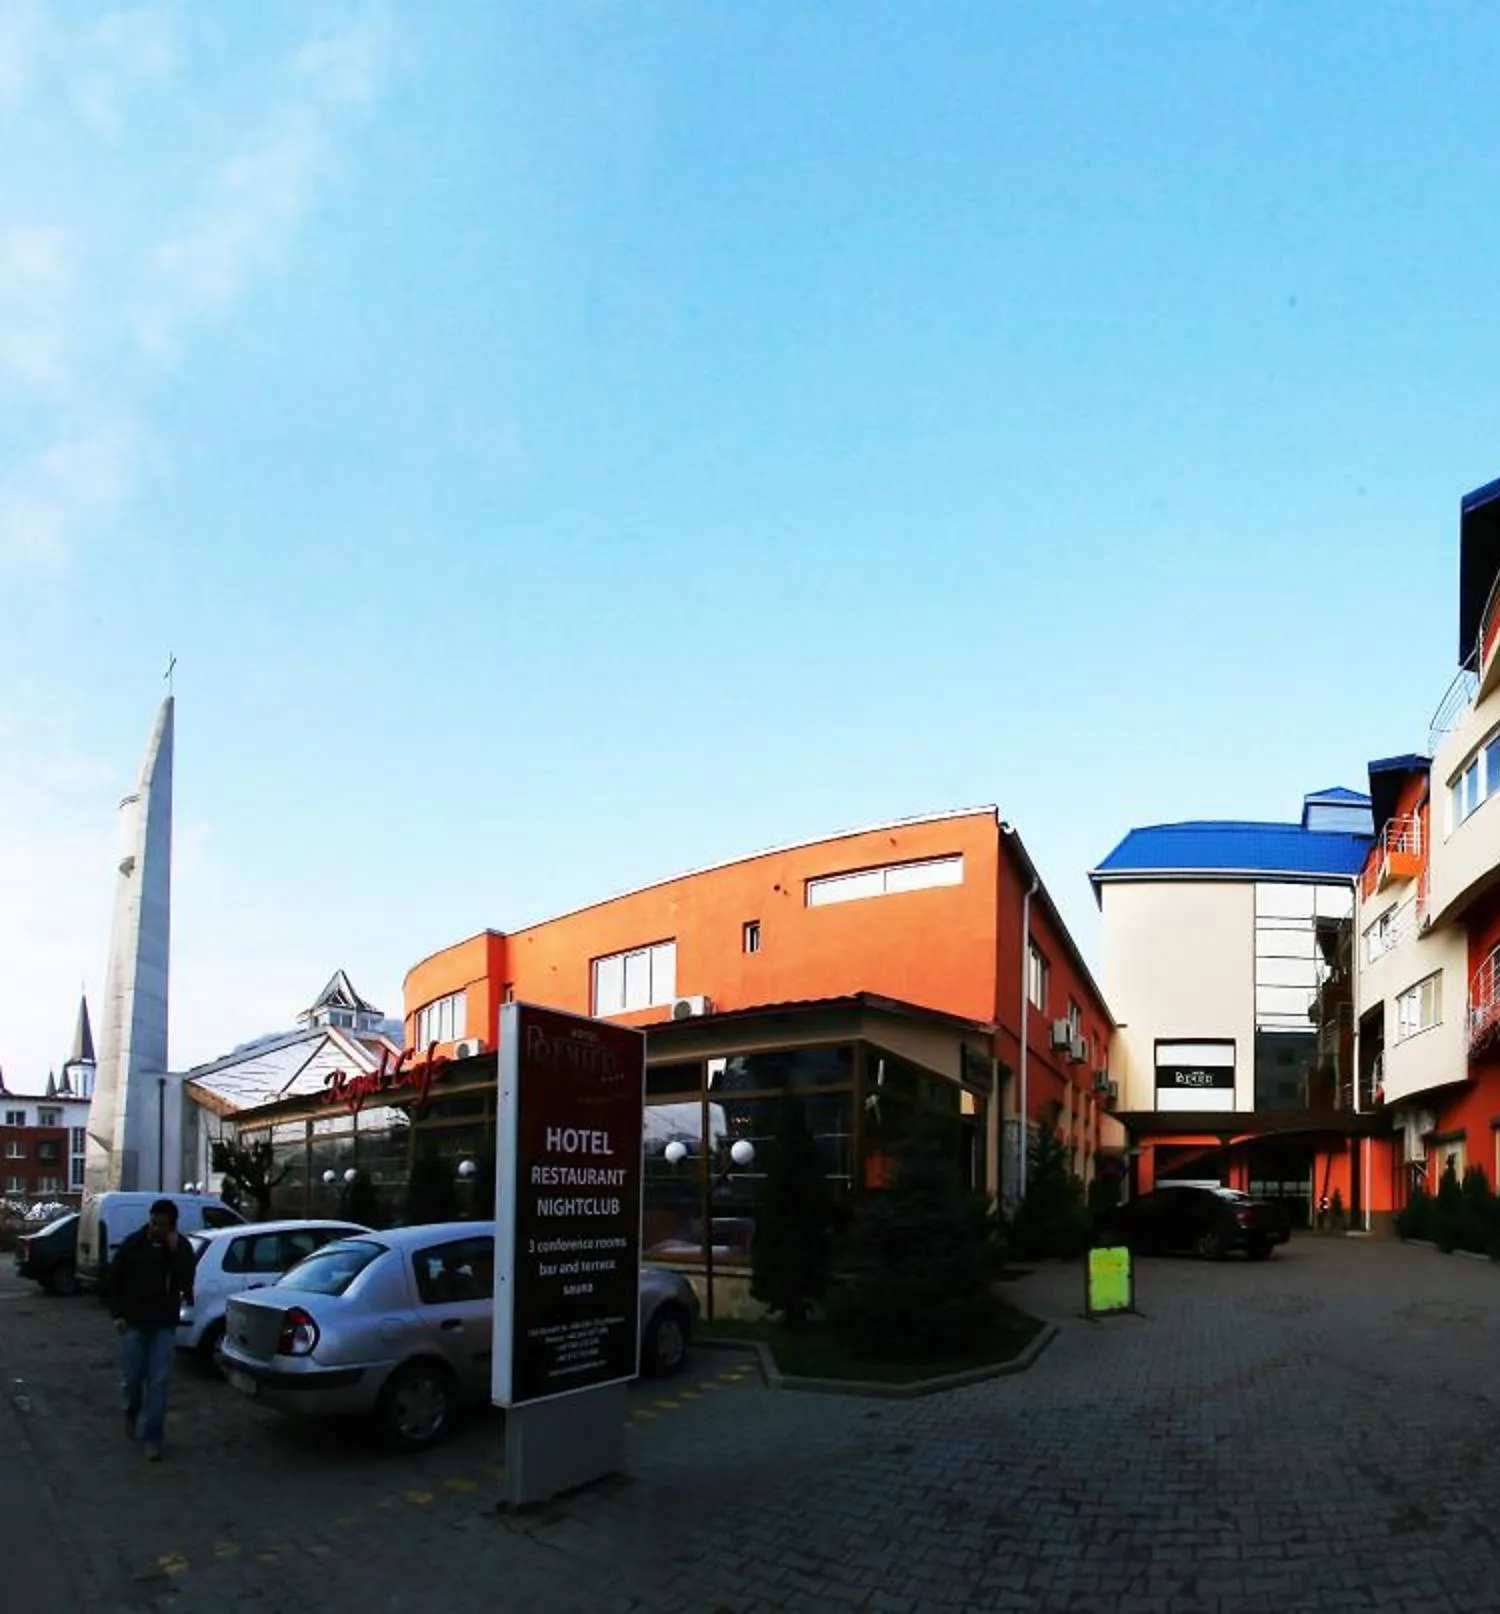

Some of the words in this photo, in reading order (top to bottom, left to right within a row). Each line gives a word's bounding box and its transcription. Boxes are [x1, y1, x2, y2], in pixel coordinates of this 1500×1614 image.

[321, 1046, 391, 1113] Royal
[546, 1127, 615, 1155] HOTEL
[531, 1166, 627, 1185] RESTAURANT
[537, 1198, 620, 1216] NIGHTCLUB
[528, 1239, 536, 1253] 3
[537, 1238, 594, 1253] conference
[595, 1238, 627, 1249] rooms
[539, 1262, 558, 1276] bar
[560, 1260, 579, 1274] and
